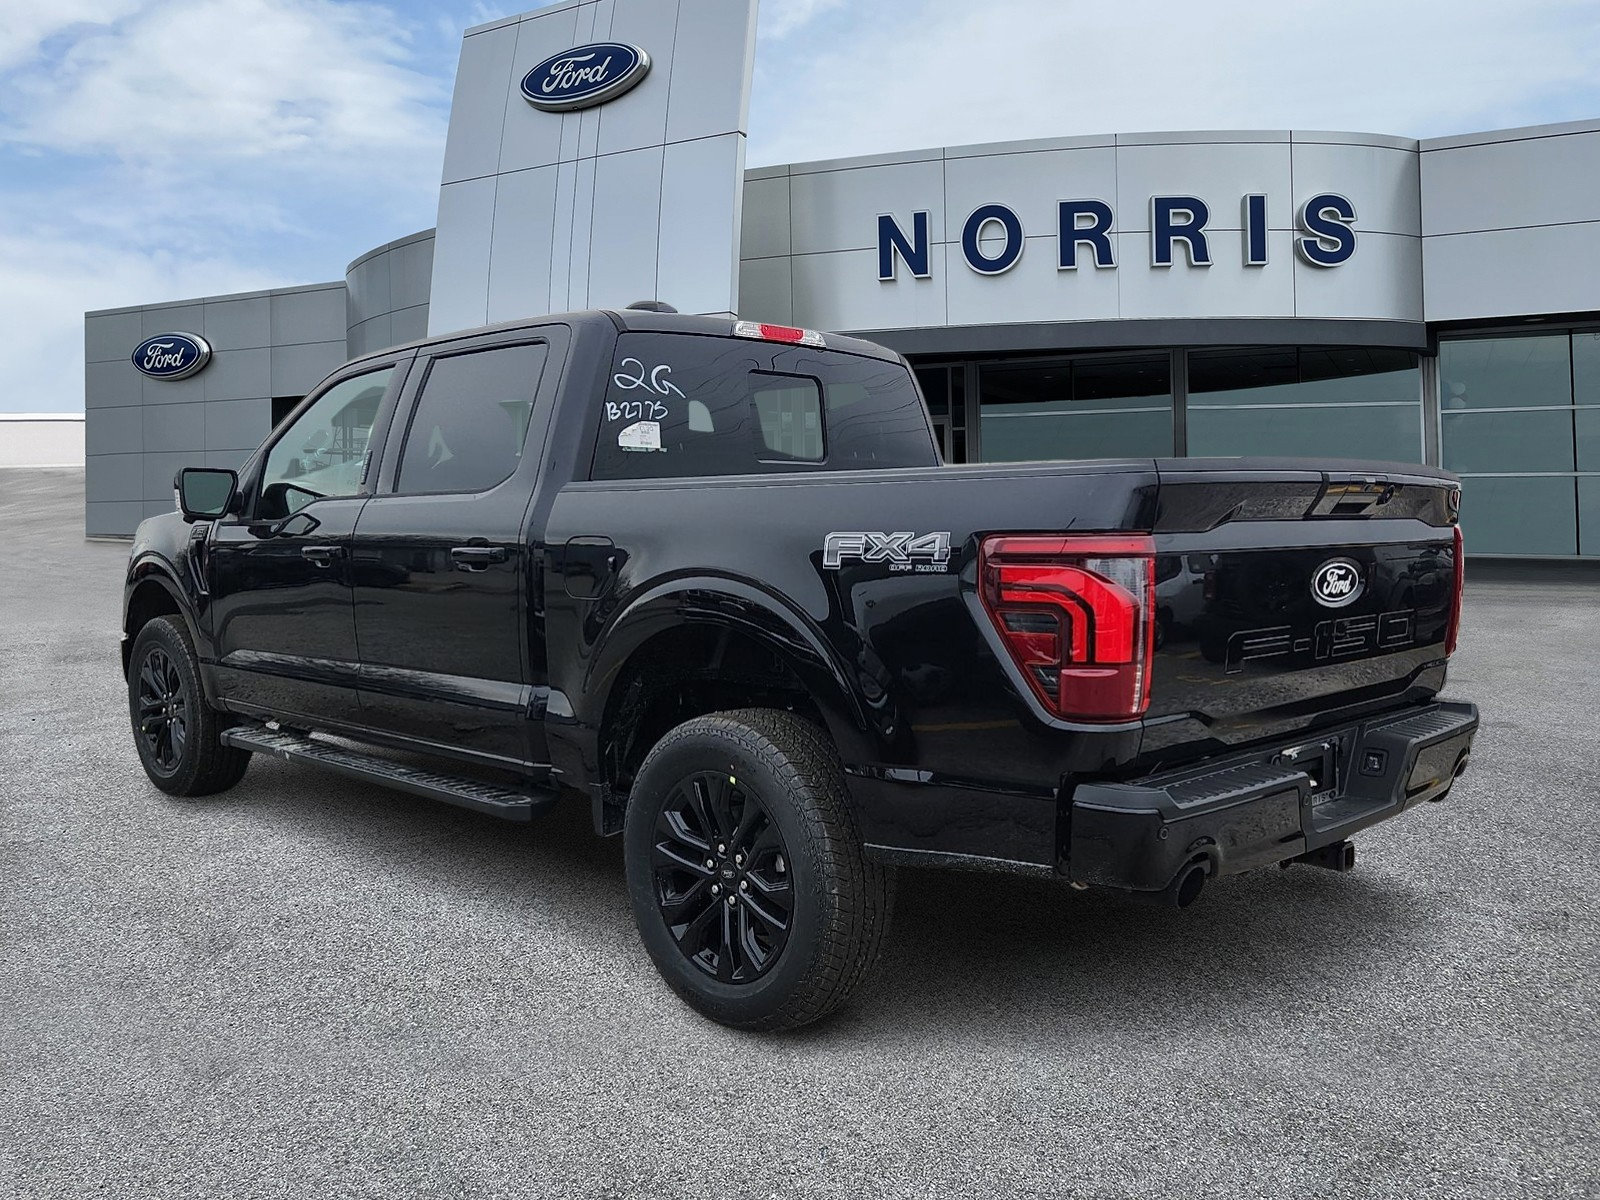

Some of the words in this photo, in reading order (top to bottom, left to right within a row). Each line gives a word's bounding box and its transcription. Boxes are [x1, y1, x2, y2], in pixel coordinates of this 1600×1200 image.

[542, 53, 612, 93] Ford
[876, 192, 1358, 281] NORRIS
[143, 342, 185, 370] Ford
[605, 401, 669, 421] B2775
[823, 531, 951, 570] FX4
[915, 564, 948, 573] ROAD
[1322, 568, 1352, 595] Ford
[1225, 608, 1415, 675] F-150
